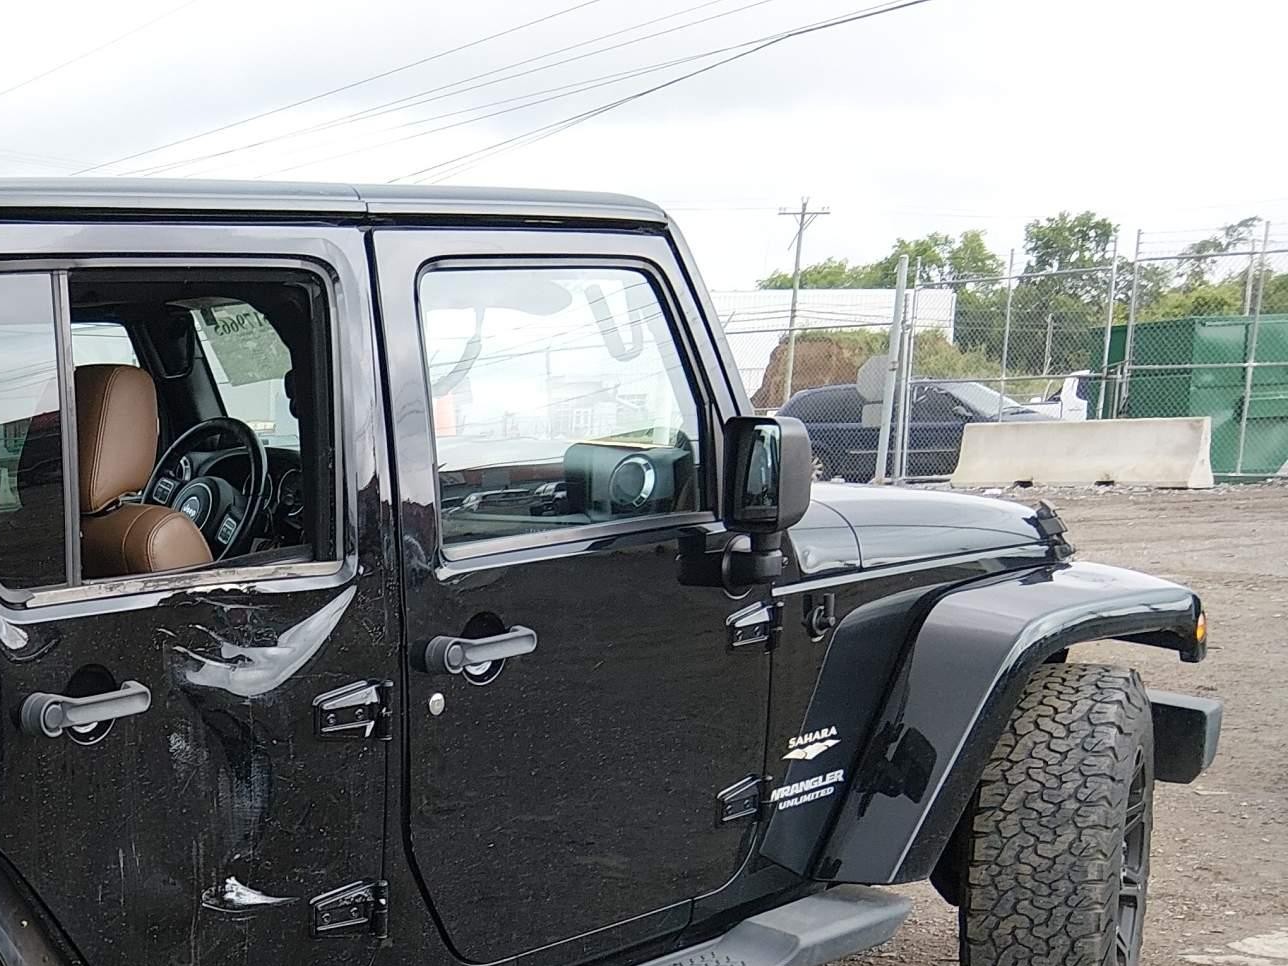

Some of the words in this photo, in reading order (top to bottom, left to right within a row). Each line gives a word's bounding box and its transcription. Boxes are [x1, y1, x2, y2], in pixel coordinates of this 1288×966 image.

[788, 726, 837, 748] SAHARA
[770, 769, 844, 802] WRANGLER
[778, 786, 835, 810] UNLIMITED
